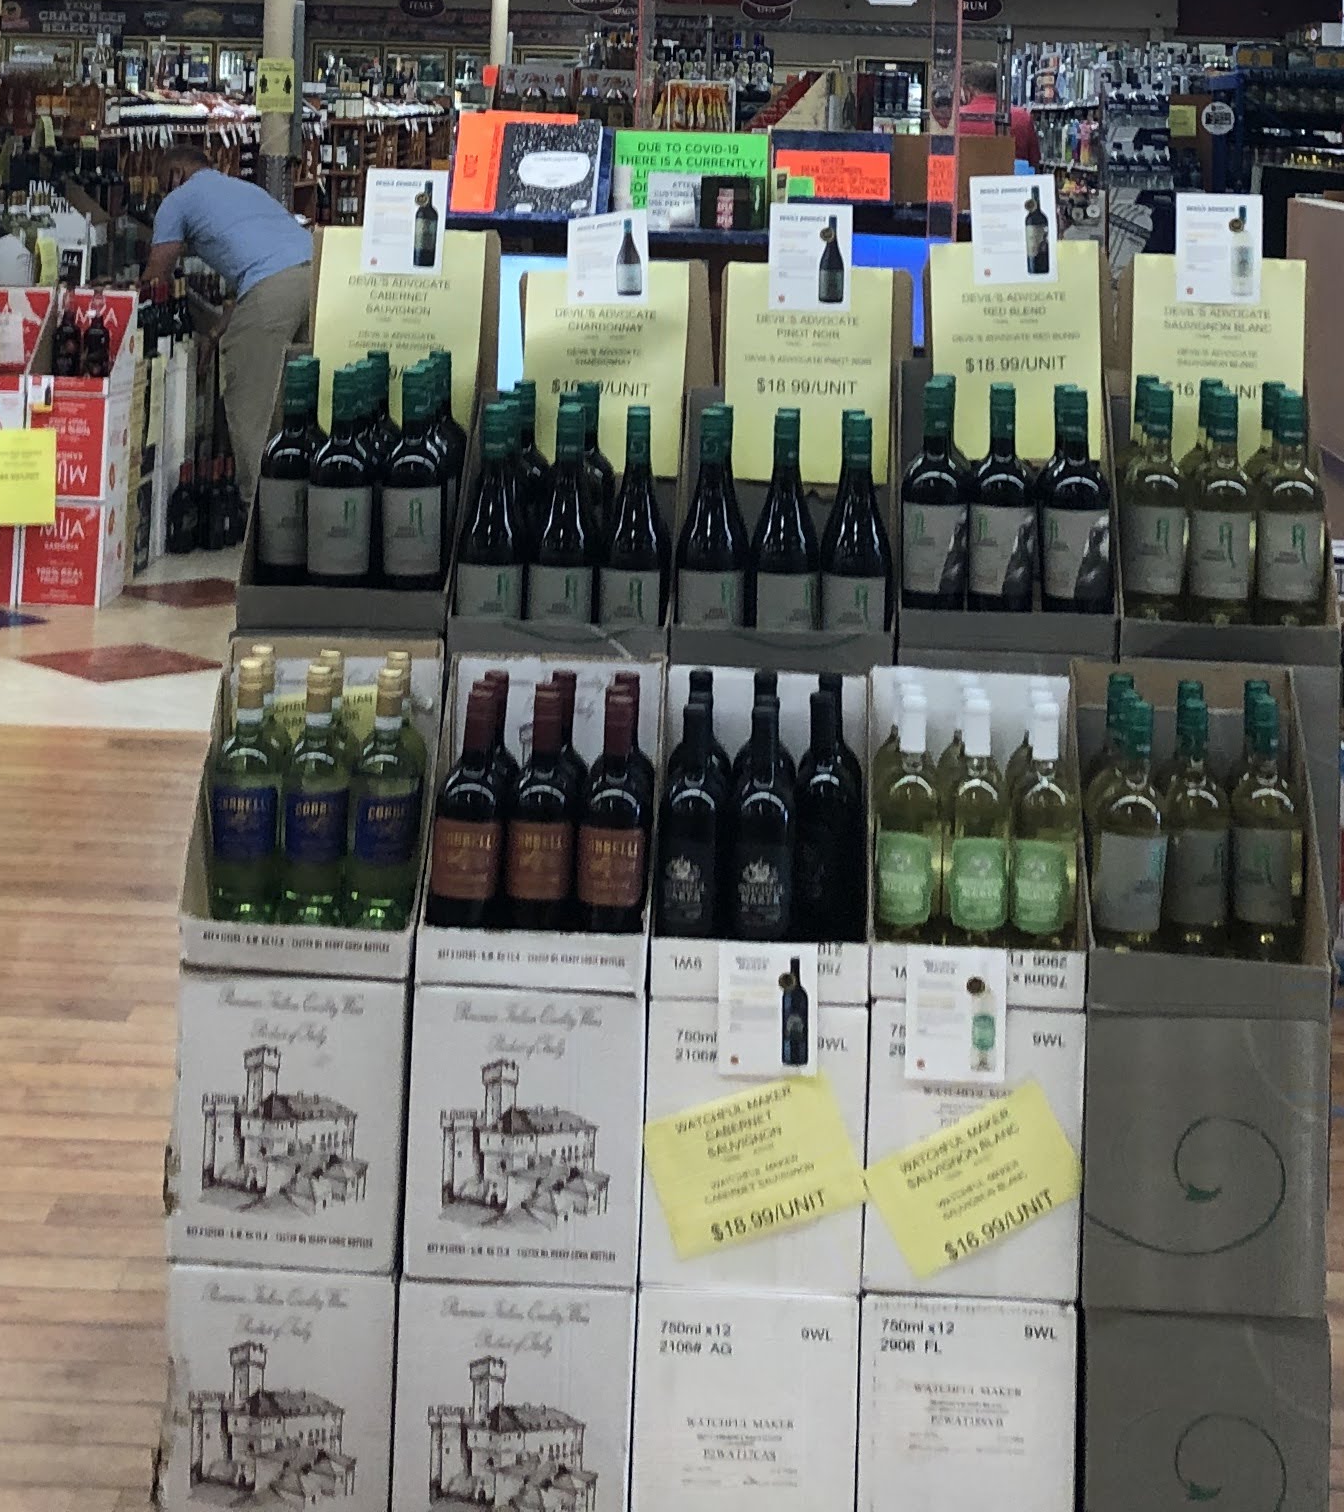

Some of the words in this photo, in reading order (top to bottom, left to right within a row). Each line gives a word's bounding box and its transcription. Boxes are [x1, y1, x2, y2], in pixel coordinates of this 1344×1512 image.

[65, 0, 102, 11] YOUR
[963, 1, 987, 11] RUM
[39, 10, 86, 23] CRAFT
[88, 11, 127, 24] BEER
[42, 21, 123, 34] SELECTION
[638, 142, 661, 153] DUE
[666, 143, 681, 154] TO
[685, 143, 739, 154] COVID-19
[619, 155, 657, 166] THERE
[660, 156, 670, 166] IS
[674, 156, 683, 166] A
[690, 156, 758, 167] CURRENTLY
[348, 275, 390, 288] DEVIL'S
[392, 277, 451, 290] ADVOCATE
[370, 291, 428, 303] CABERNET
[1007, 291, 1066, 302] ADVOCATE
[365, 303, 431, 317] SAUVIGNON
[598, 309, 656, 320] ADVOCATE
[983, 306, 1006, 316] RED
[1009, 305, 1046, 316] BLEND
[1210, 308, 1271, 320] ADVOCATE
[800, 315, 859, 326] ADVOCATE
[1164, 320, 1231, 332] SAUVIGNON
[568, 322, 643, 333] CHARDONNAY
[777, 329, 809, 339] PINOT
[812, 329, 840, 340] NOIR
[966, 355, 1067, 374] $18.99/UNIT
[756, 376, 858, 395] $18.99/UNIT
[675, 1104, 741, 1134] WATCHFUL
[747, 1085, 791, 1110] MAKER
[706, 1110, 771, 1141] CABERNET
[707, 1126, 782, 1158] SAUVIGNON
[900, 1137, 965, 1174] WATCHFUL
[967, 1108, 1009, 1138] MAKER
[907, 1145, 979, 1190] SAUVIGNON
[979, 1123, 1019, 1152] BLANC
[711, 1188, 825, 1242] $18.99/UNIT
[945, 1188, 1053, 1261] $16.99/UNIT
[660, 1320, 701, 1336] 750ml
[716, 1322, 732, 1337] 12
[882, 1319, 924, 1334] 750ml
[940, 1321, 955, 1335] 12
[1024, 1325, 1057, 1340] 9WL
[801, 1327, 833, 1342] 9WL
[914, 1384, 974, 1396] WATCHFUL
[981, 1387, 1022, 1397] MAKER
[687, 1417, 747, 1428] WATCHFUL
[753, 1418, 794, 1429] MAKER
